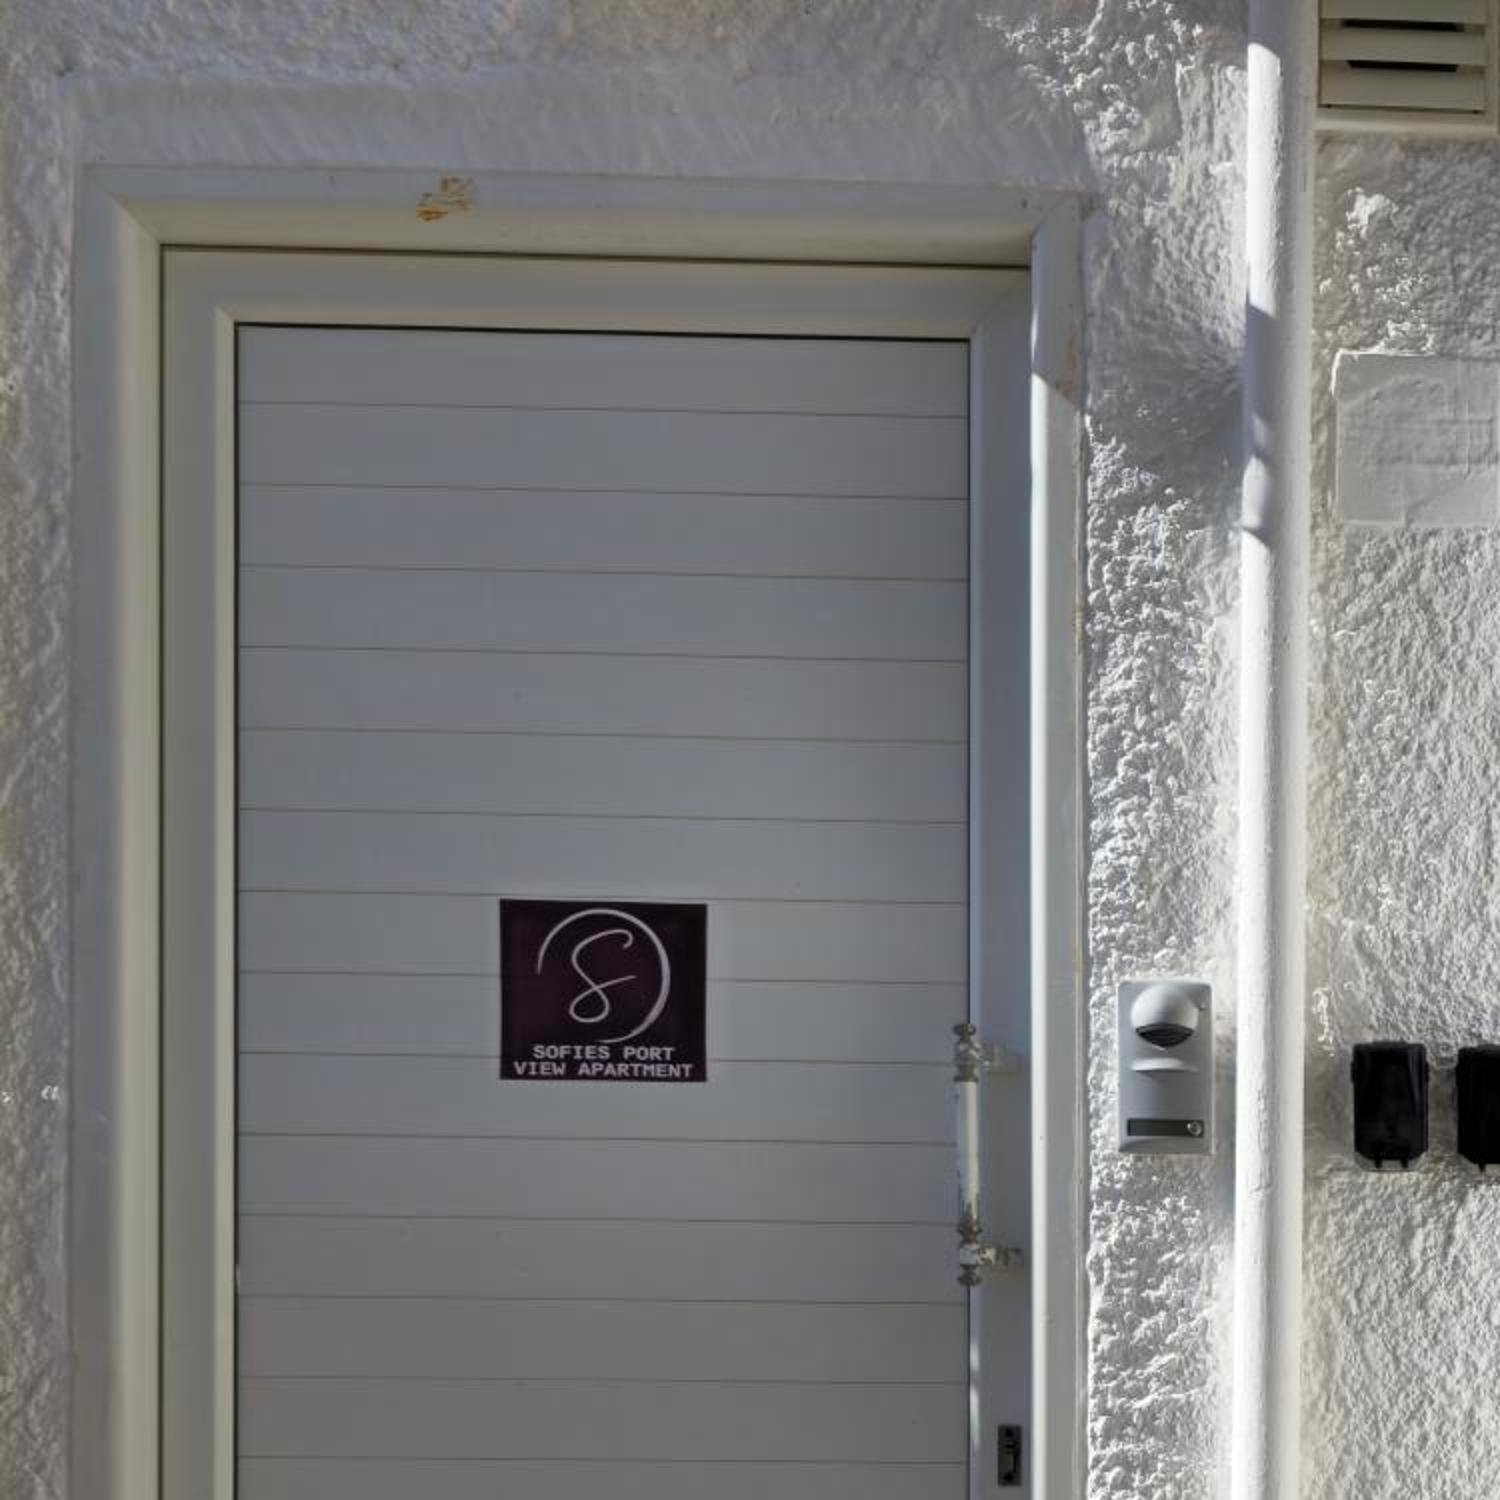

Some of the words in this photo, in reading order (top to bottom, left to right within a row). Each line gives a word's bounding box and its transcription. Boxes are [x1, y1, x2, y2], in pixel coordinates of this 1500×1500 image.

[533, 1045, 610, 1060] SOFIES
[623, 1046, 675, 1061] PORT
[513, 1061, 566, 1076] VIEW
[577, 1062, 693, 1078] APARTMENT
